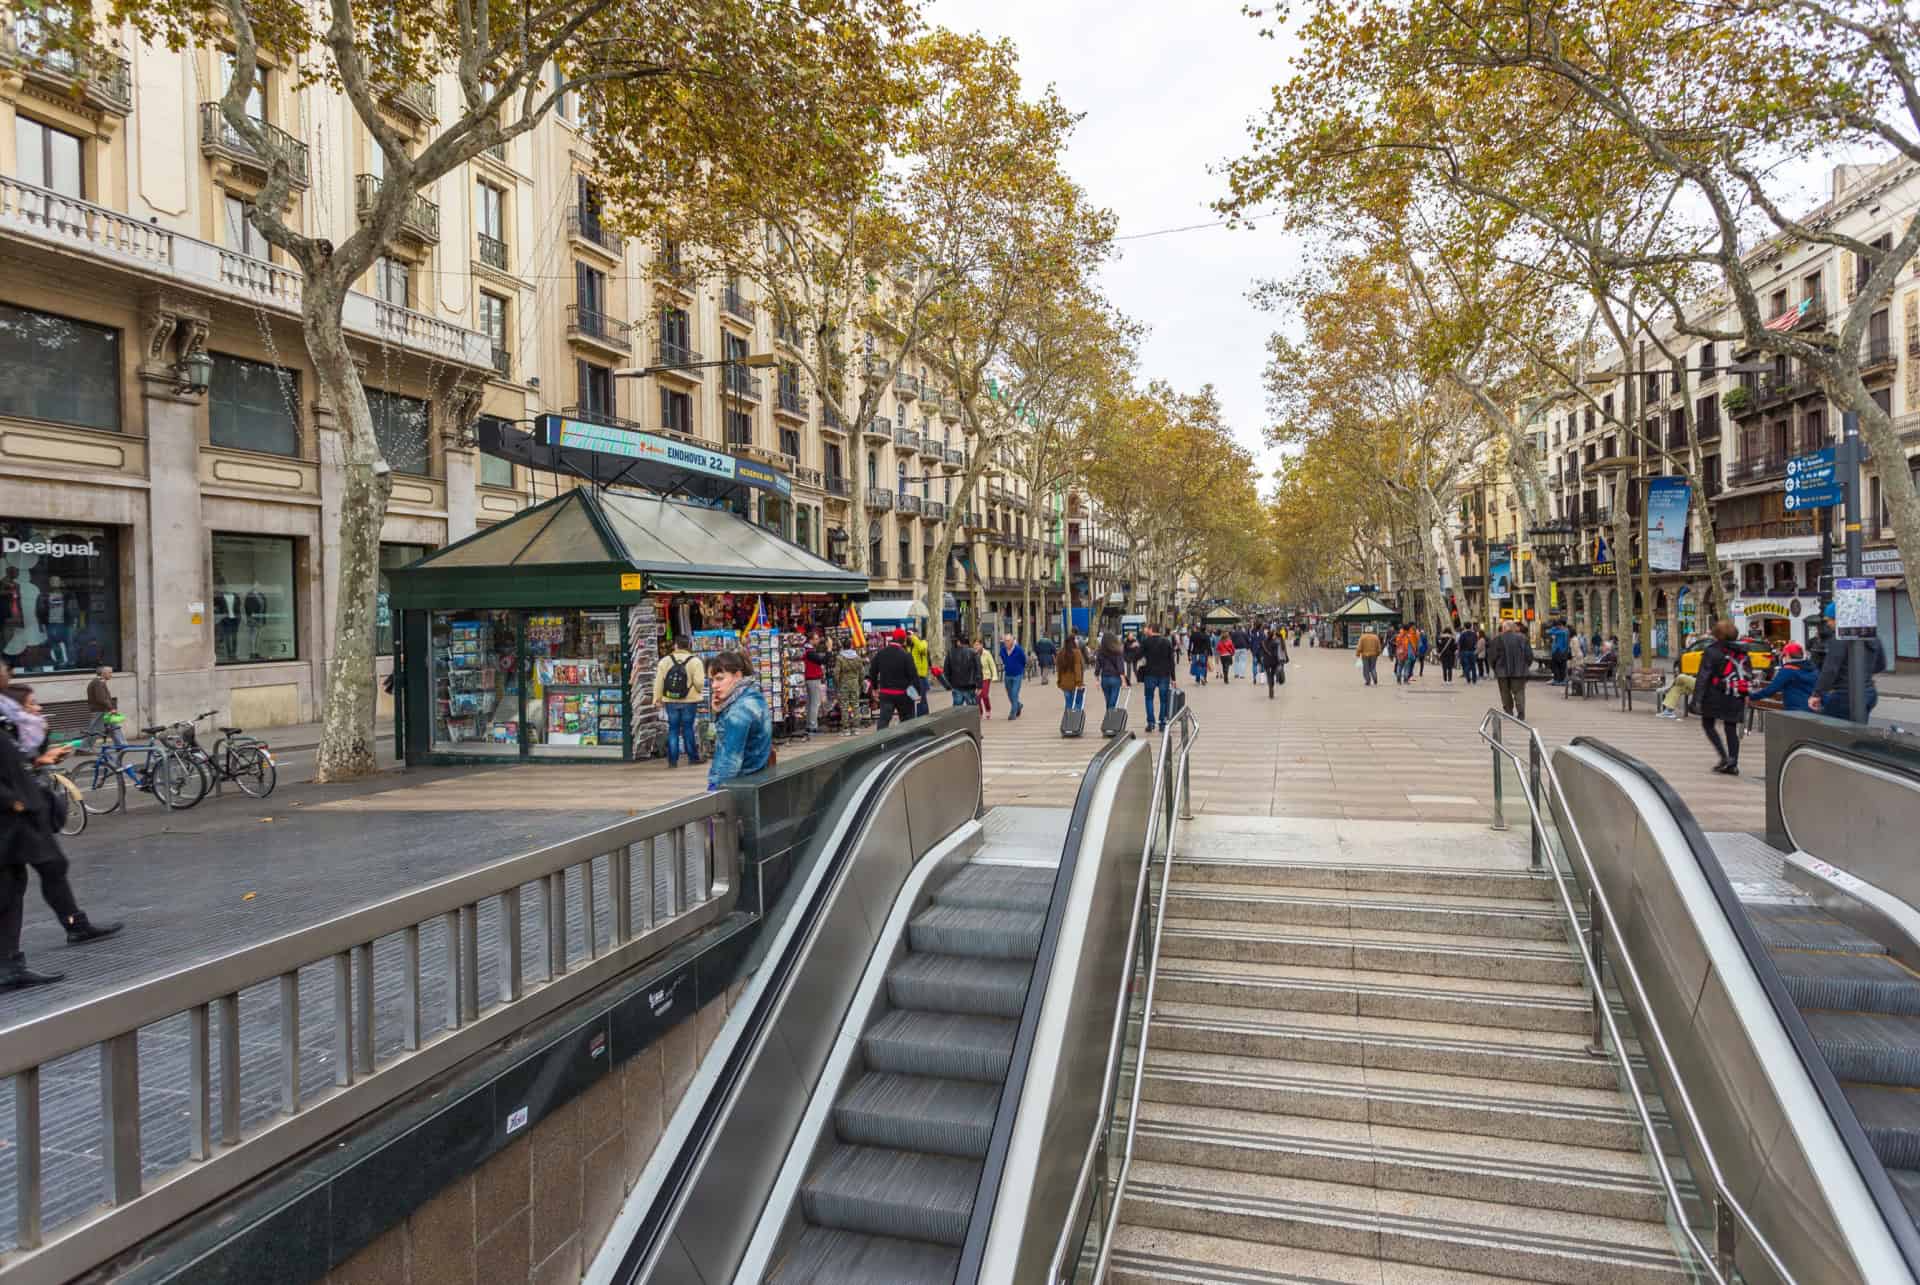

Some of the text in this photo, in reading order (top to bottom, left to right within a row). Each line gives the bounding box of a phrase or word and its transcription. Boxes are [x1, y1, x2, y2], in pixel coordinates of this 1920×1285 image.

[667, 447, 707, 467] EINDHOVEN
[709, 456, 723, 471] 22
[1592, 562, 1616, 576] HOTEL
